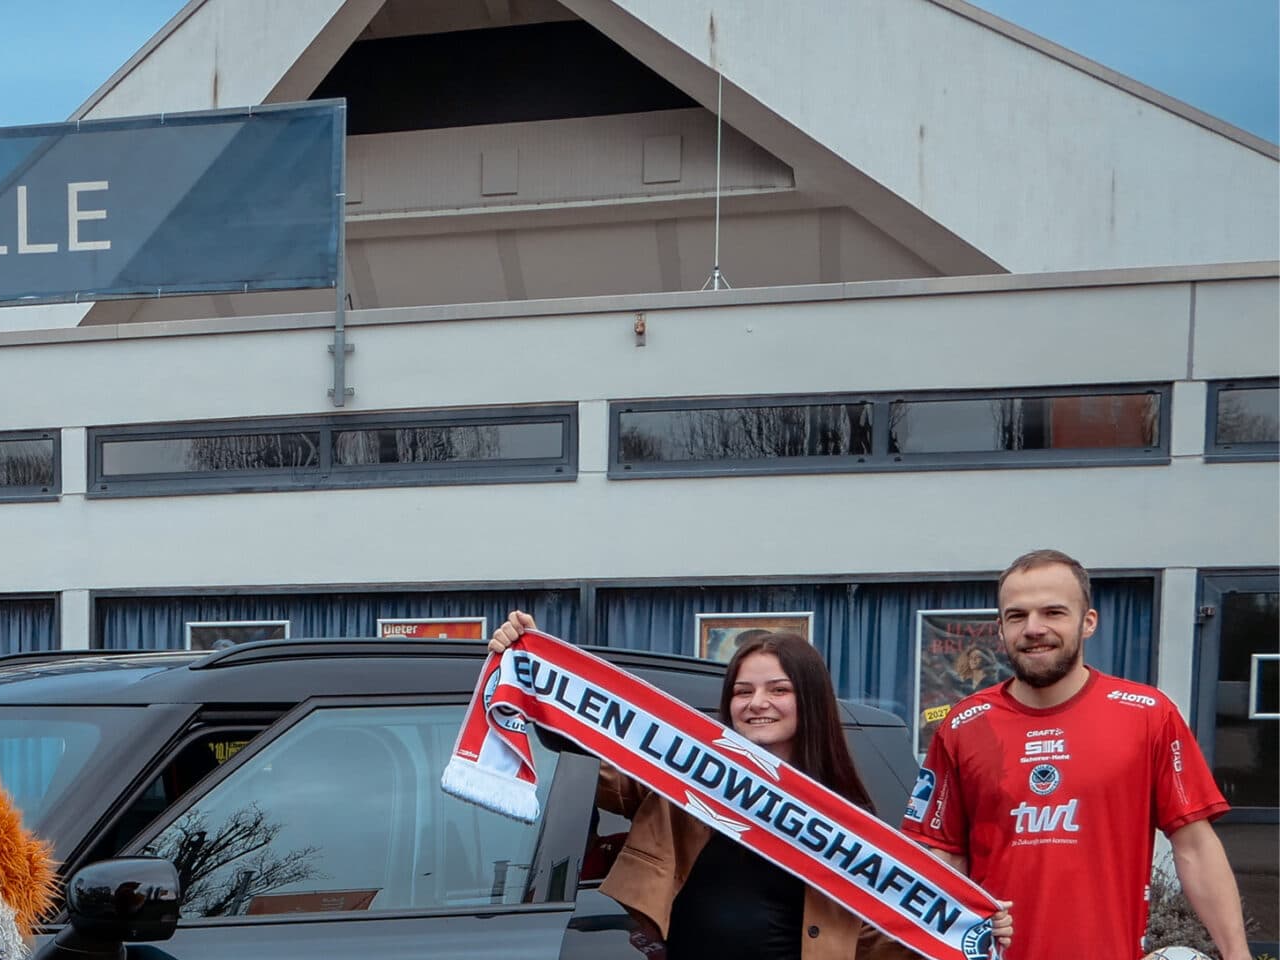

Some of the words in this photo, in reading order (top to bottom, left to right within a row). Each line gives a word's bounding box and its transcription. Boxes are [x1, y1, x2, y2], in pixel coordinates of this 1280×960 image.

[1122, 692, 1156, 706] LOTTO
[958, 703, 992, 720] LOTTO
[513, 655, 632, 739] EULEN
[639, 724, 962, 936] LUDWIGSHAFEN
